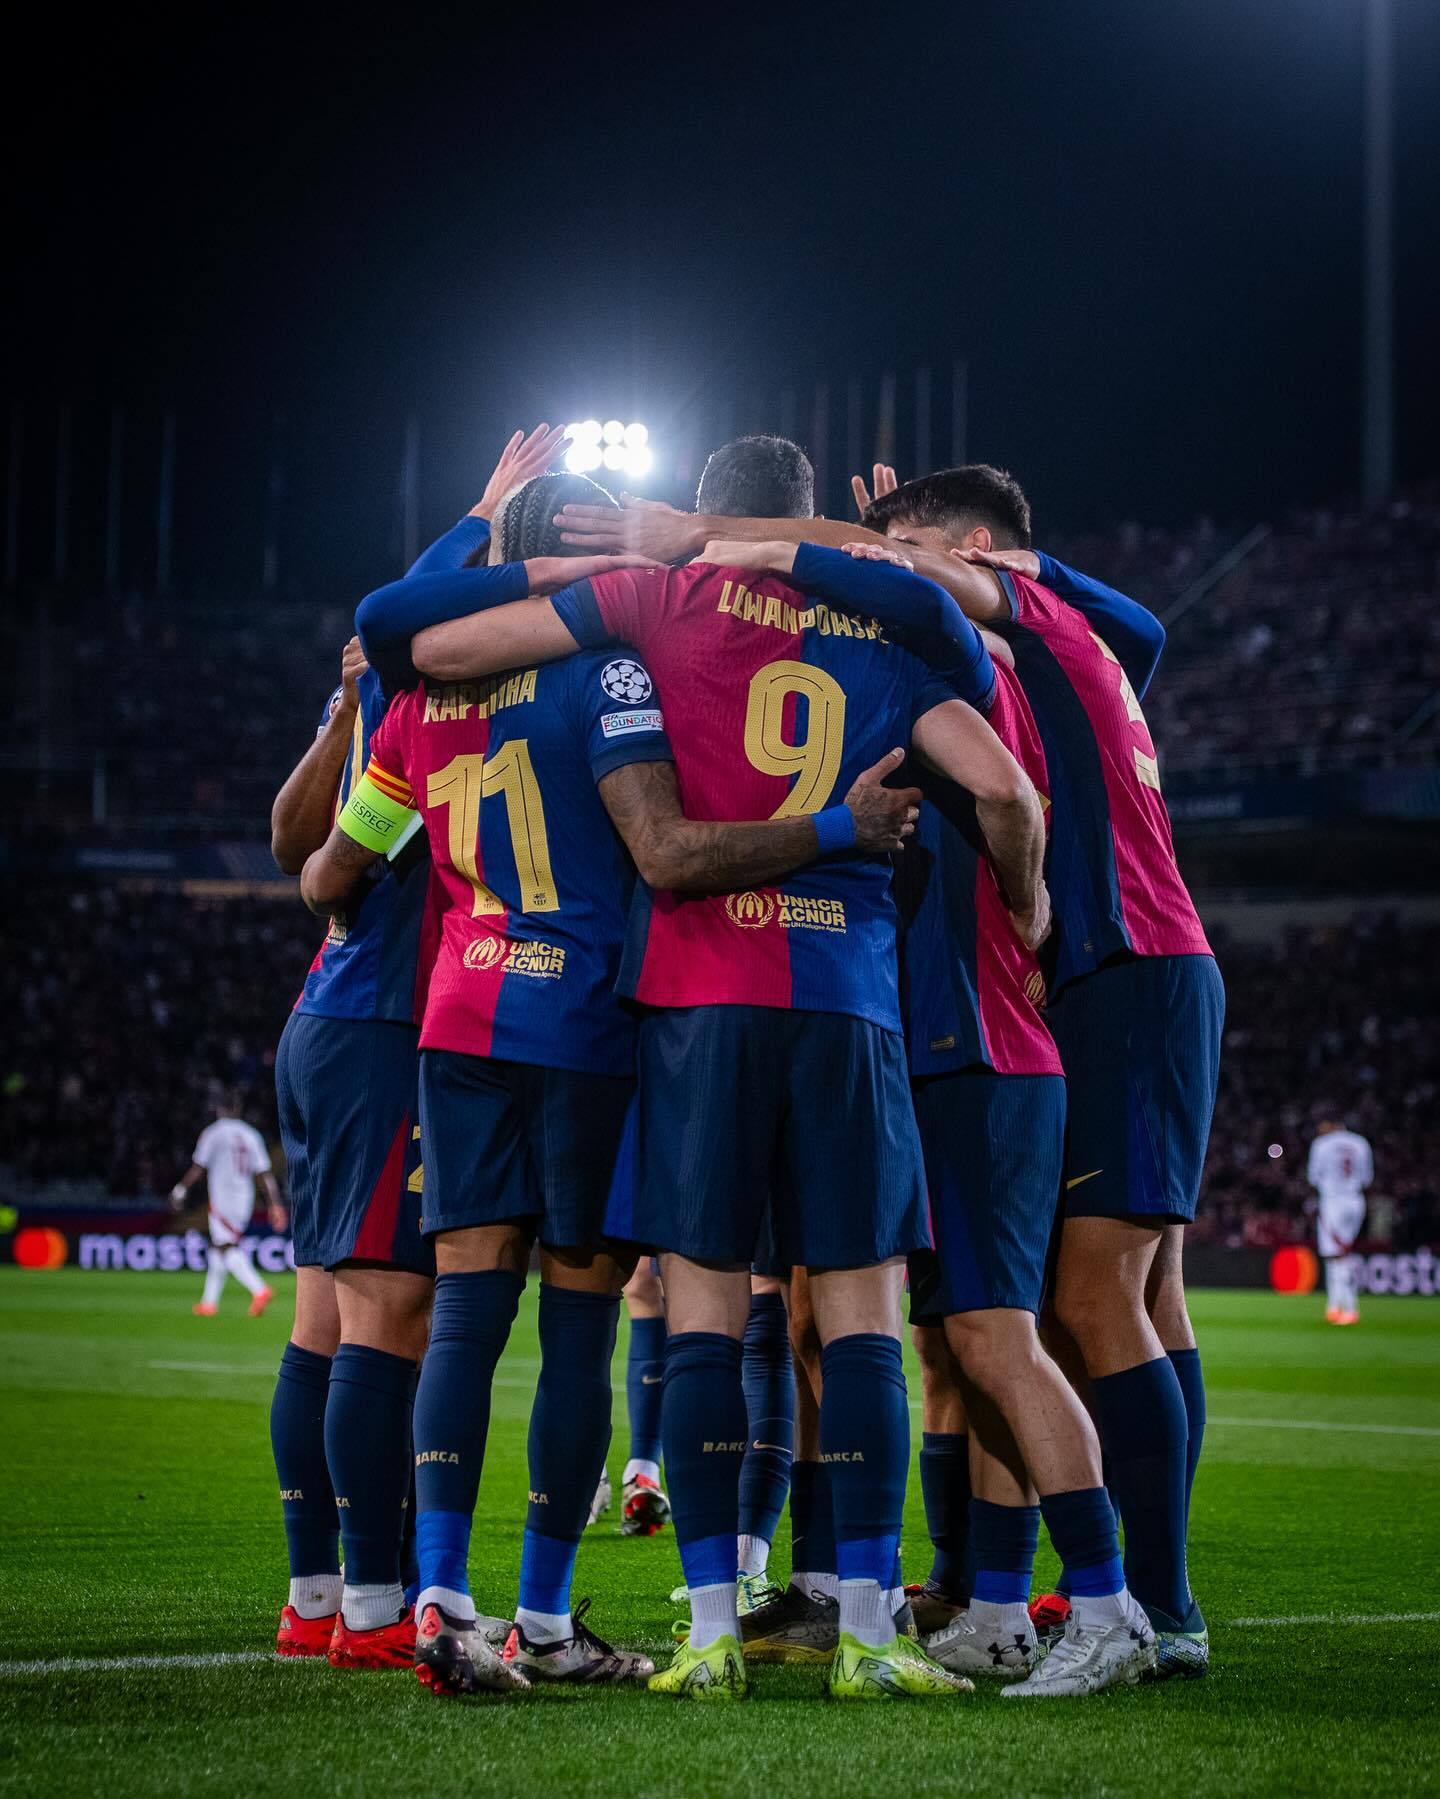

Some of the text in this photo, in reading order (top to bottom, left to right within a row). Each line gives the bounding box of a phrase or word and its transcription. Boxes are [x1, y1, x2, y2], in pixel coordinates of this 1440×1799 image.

[744, 659, 847, 820] 9
[351, 797, 394, 833] RESPECT
[427, 738, 560, 918] 11
[776, 893, 845, 913] UNHCR
[777, 906, 847, 928] ACNUR
[509, 941, 566, 960] UNHCR
[501, 954, 564, 973] ACNUR
